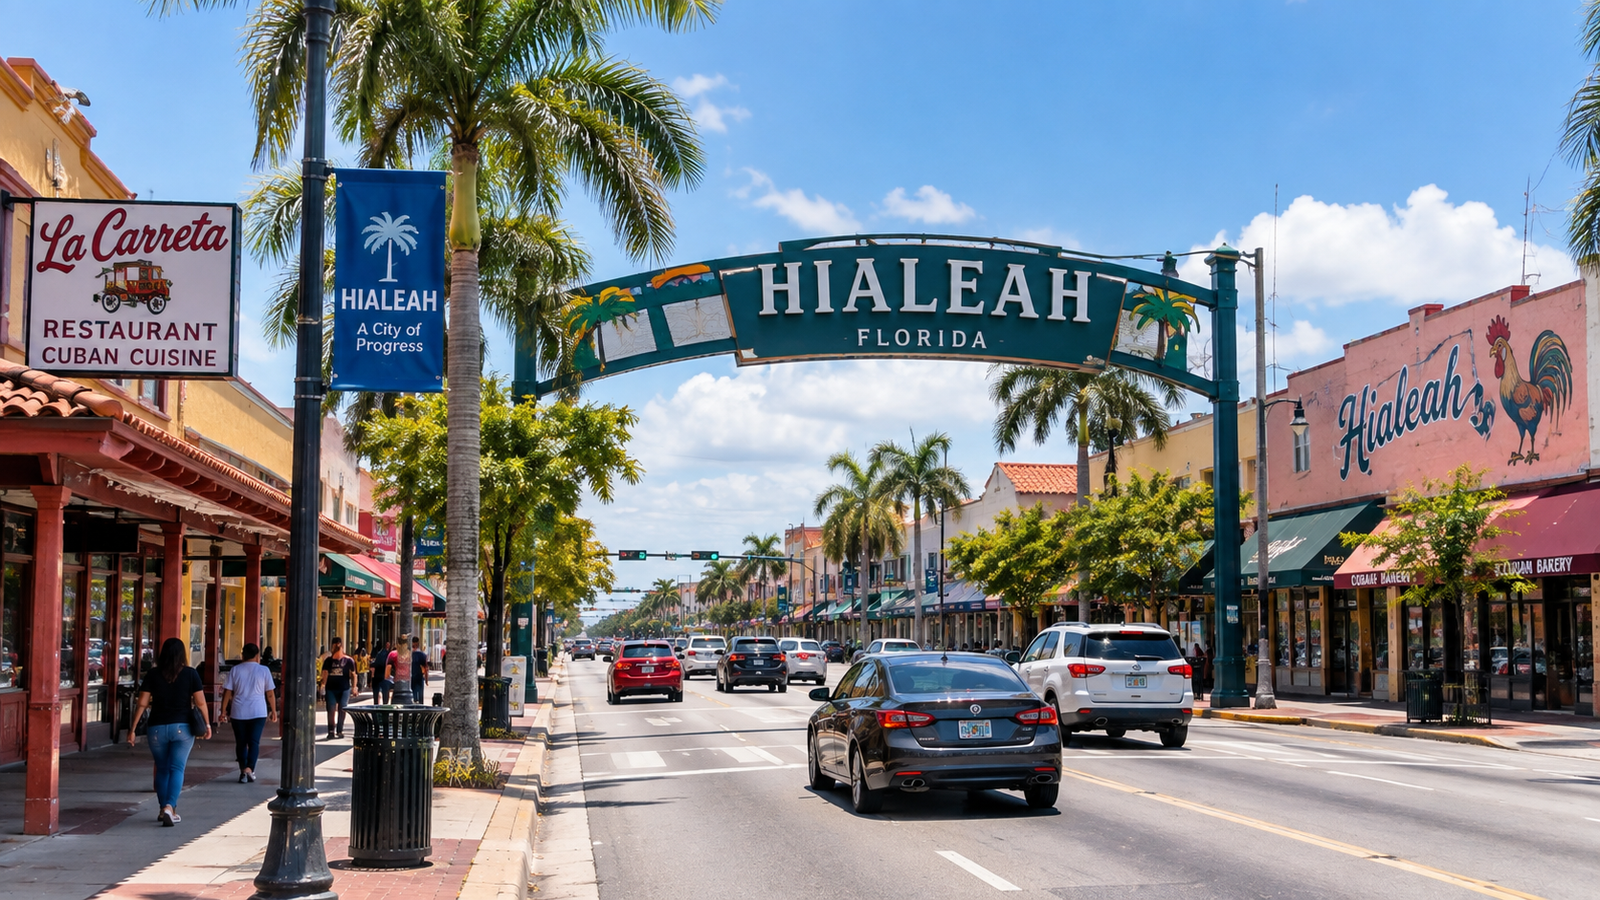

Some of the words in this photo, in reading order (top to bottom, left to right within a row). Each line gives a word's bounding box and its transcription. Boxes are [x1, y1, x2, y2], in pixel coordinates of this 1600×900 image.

[36, 214, 87, 274] La
[91, 207, 229, 262] Carreta
[341, 288, 437, 312] HIALEAH
[758, 258, 1092, 323] HIALEAH
[43, 319, 218, 341] RESTAURANT
[356, 322, 369, 335] A
[372, 322, 401, 339] City
[405, 322, 422, 336] of
[857, 328, 987, 349] FLORIDA
[42, 346, 119, 364] CUBAN
[130, 348, 217, 366] CUISINE
[356, 337, 424, 356] Progress
[1338, 343, 1472, 482] Hialeah
